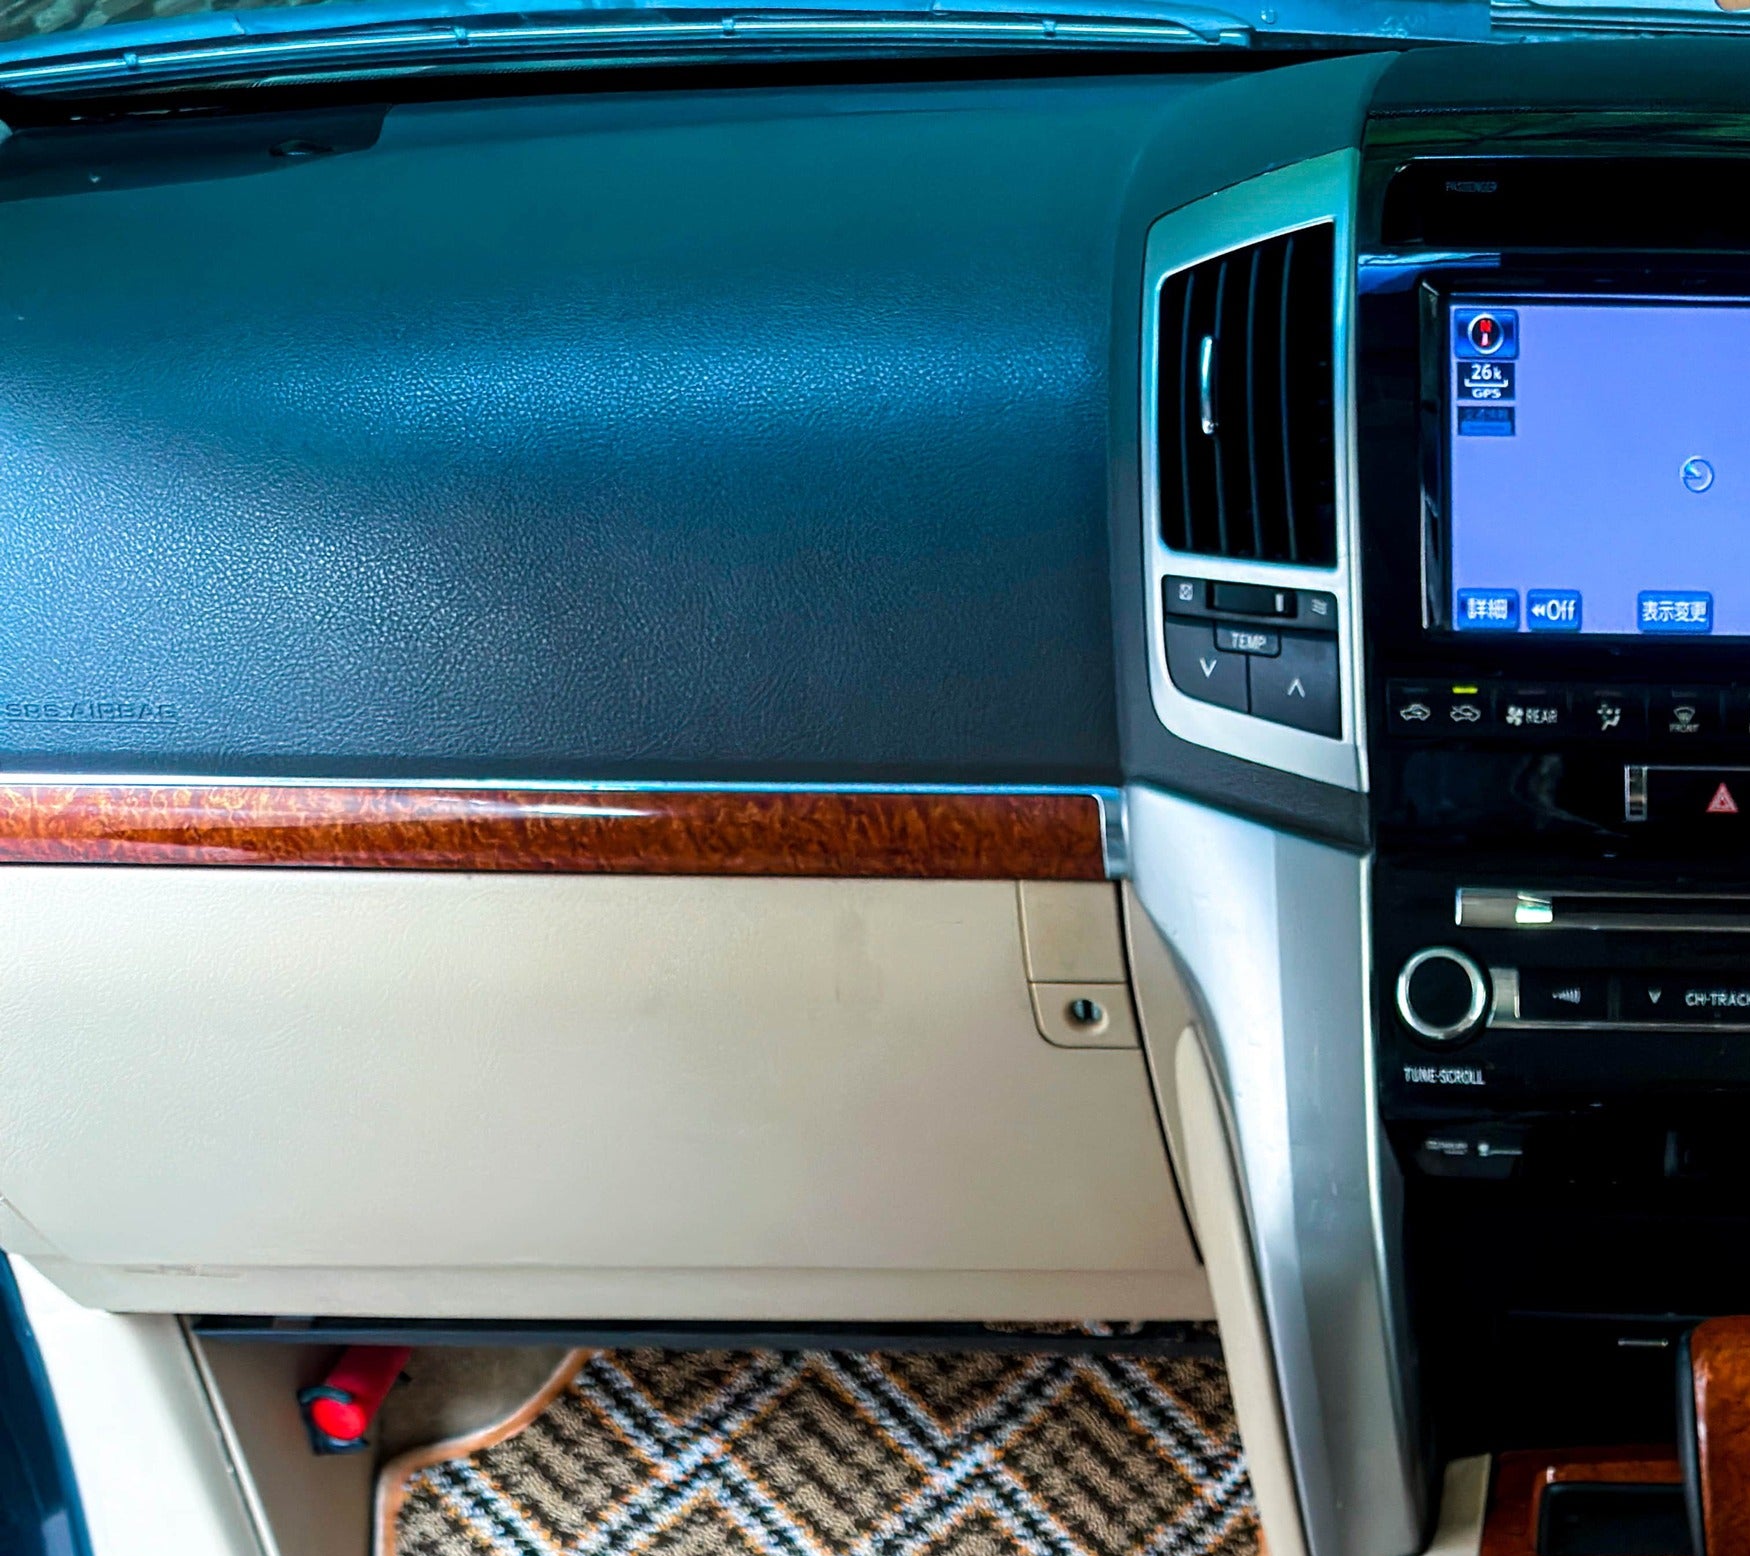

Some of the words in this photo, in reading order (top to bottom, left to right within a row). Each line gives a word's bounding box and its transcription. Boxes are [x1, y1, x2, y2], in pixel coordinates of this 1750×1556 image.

[1472, 387, 1502, 399] GPS
[1467, 598, 1508, 620] 詳細
[1546, 599, 1577, 621] Off
[1641, 600, 1708, 624] 表示変更
[1231, 632, 1268, 650] TEMP
[1525, 707, 1559, 724] REAR
